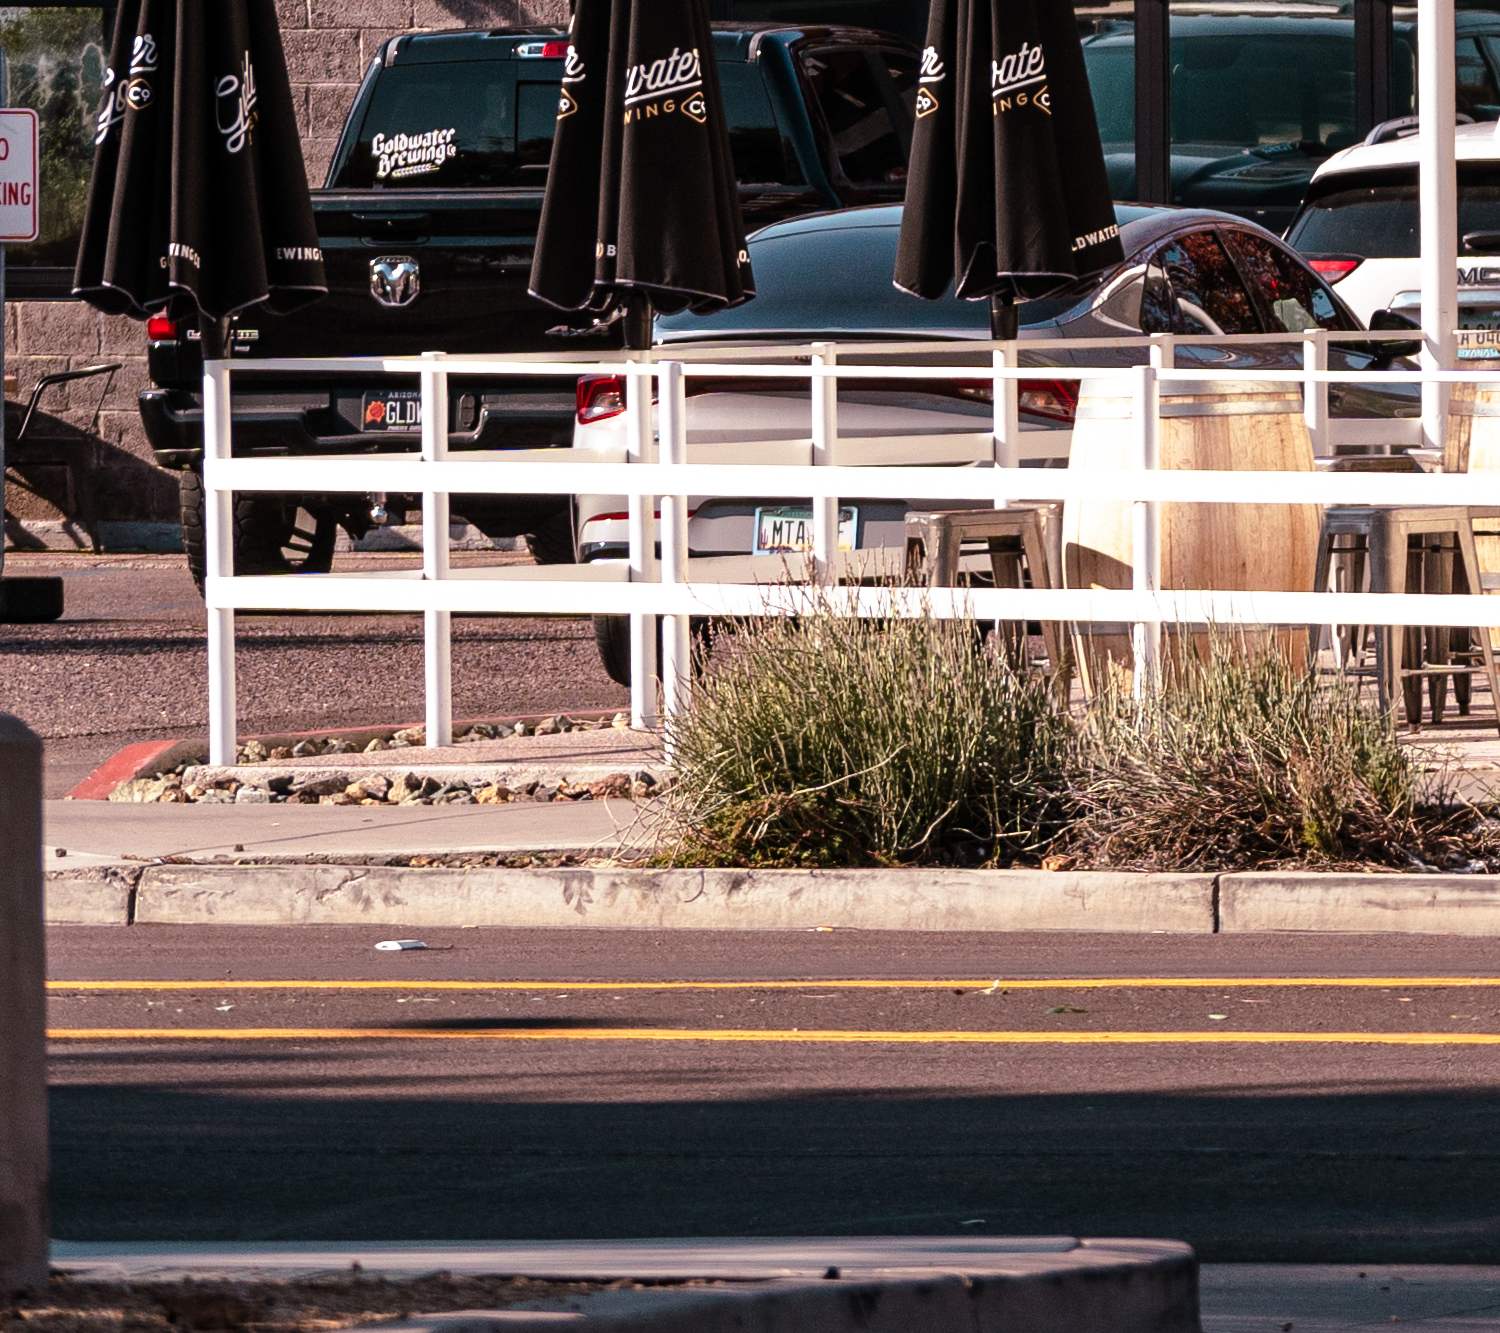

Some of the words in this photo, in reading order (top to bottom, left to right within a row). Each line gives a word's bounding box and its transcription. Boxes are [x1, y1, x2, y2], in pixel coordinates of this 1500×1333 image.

[371, 128, 456, 157] Goldwater
[377, 143, 447, 178] Brewing
[0, 182, 31, 206] ING
